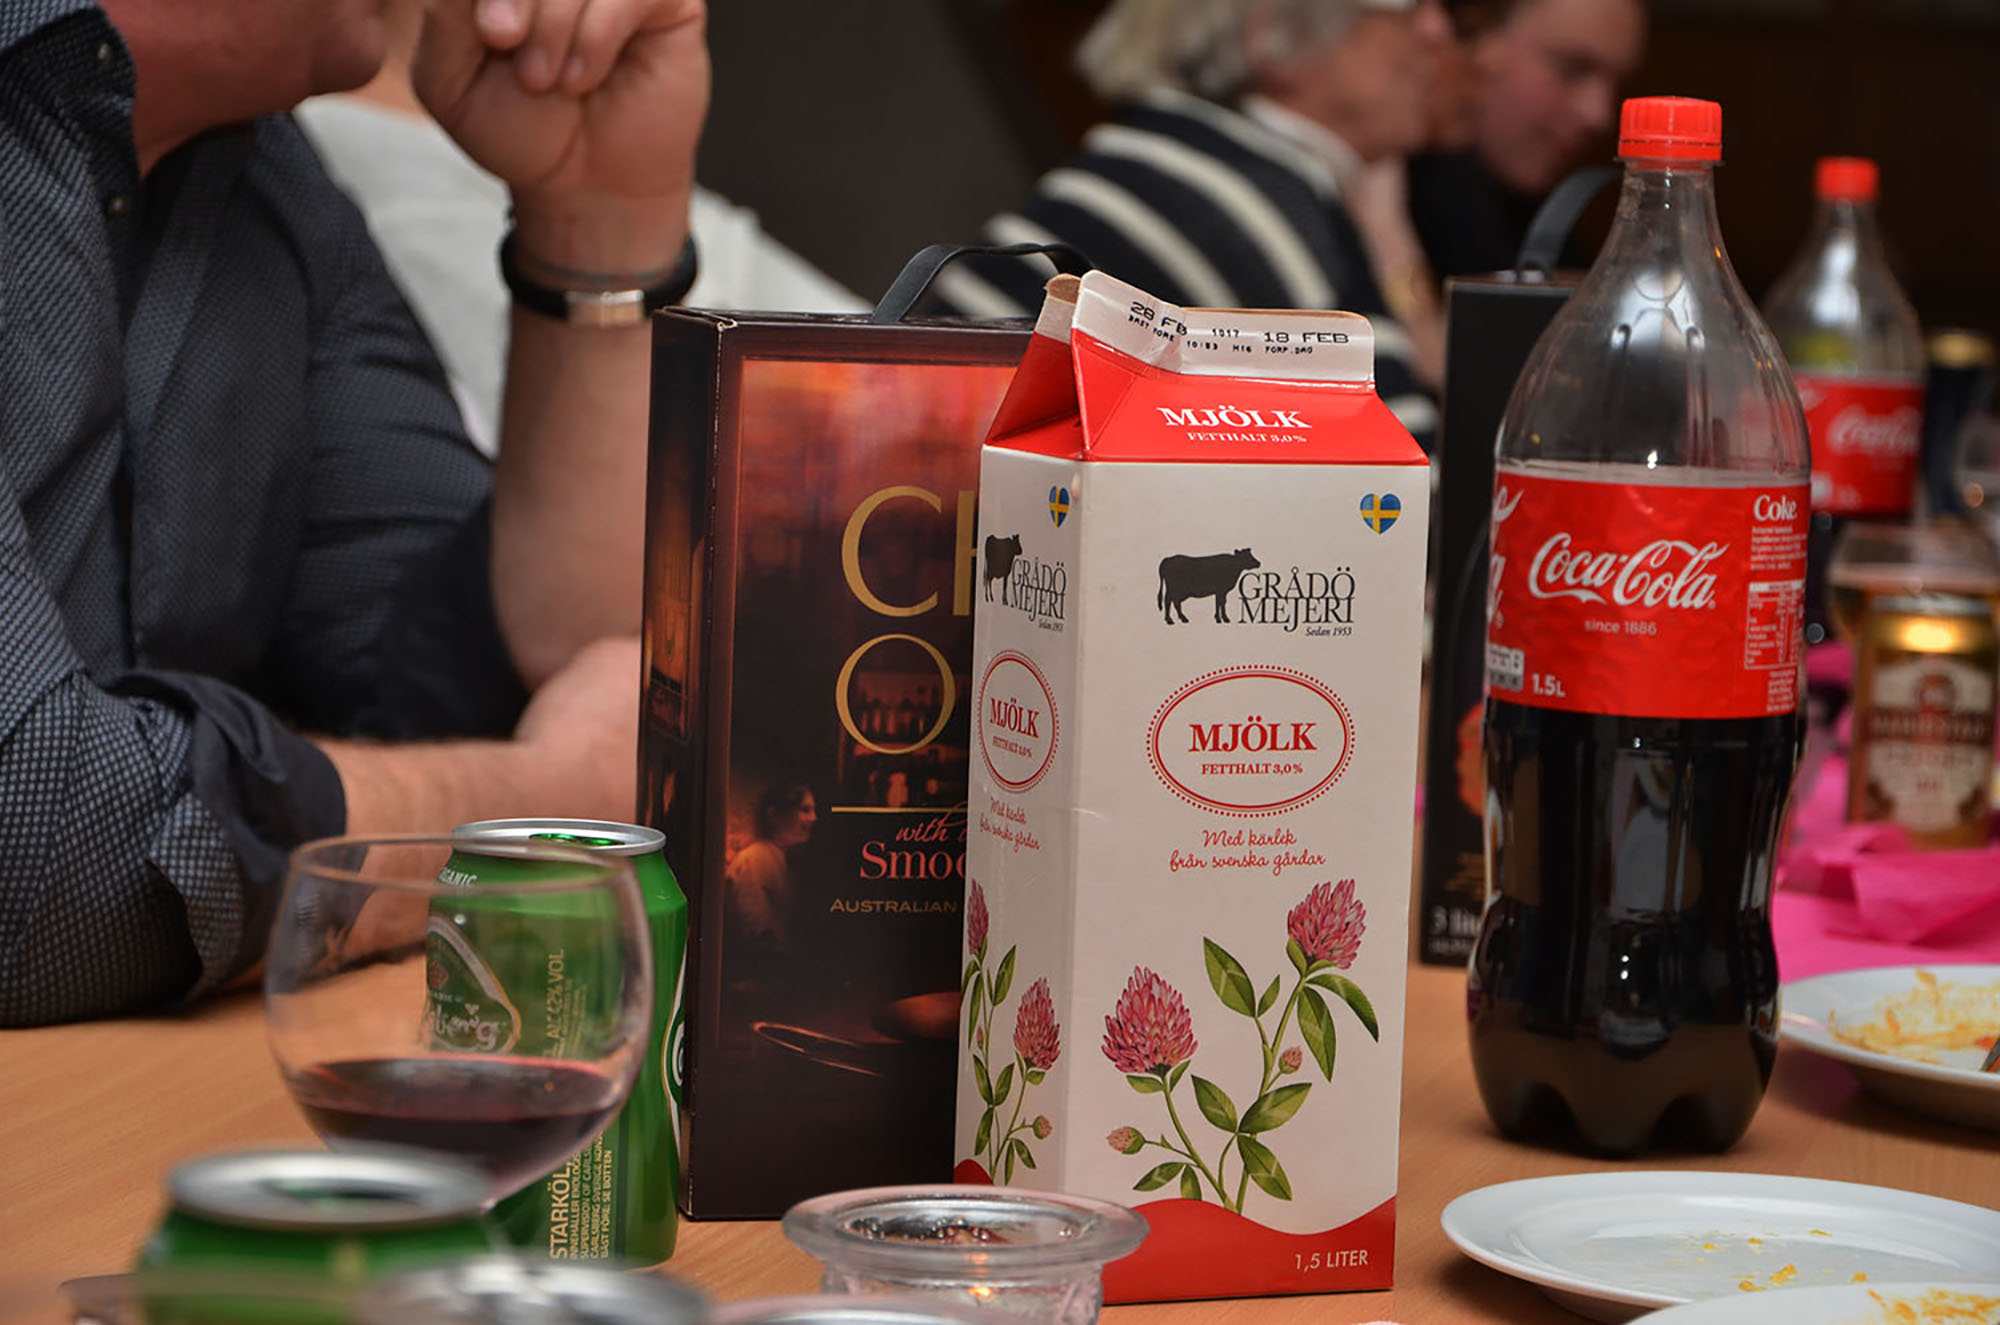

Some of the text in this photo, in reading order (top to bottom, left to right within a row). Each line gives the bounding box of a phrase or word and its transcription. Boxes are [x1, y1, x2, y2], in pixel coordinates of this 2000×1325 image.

[1130, 301, 1155, 321] 28
[1264, 332, 1349, 344] 18 FEB
[1156, 405, 1312, 428] MJÖLK
[1187, 432, 1267, 442] FETTHALT
[1754, 495, 1797, 521] Coke
[1012, 557, 1066, 596] GRÅDÖ
[1238, 566, 1356, 600] GRÅDÖ
[1528, 532, 1730, 609] Coca-Cola
[1010, 585, 1065, 622] MEJERI
[1238, 597, 1355, 632] MEJERI
[1305, 626, 1352, 637] Sedan 1953
[1585, 619, 1619, 633] since
[989, 697, 1040, 738] MJÖLK
[1188, 715, 1317, 752] MJÖLK
[1201, 763, 1272, 775] FETTHALT
[896, 815, 950, 841] with
[1202, 827, 1297, 847] Med kärlek
[1169, 849, 1326, 876] från svenska gårdar
[830, 898, 957, 913] AUSTRALIAN
[1295, 1249, 1368, 1273] 1,5 LITER
